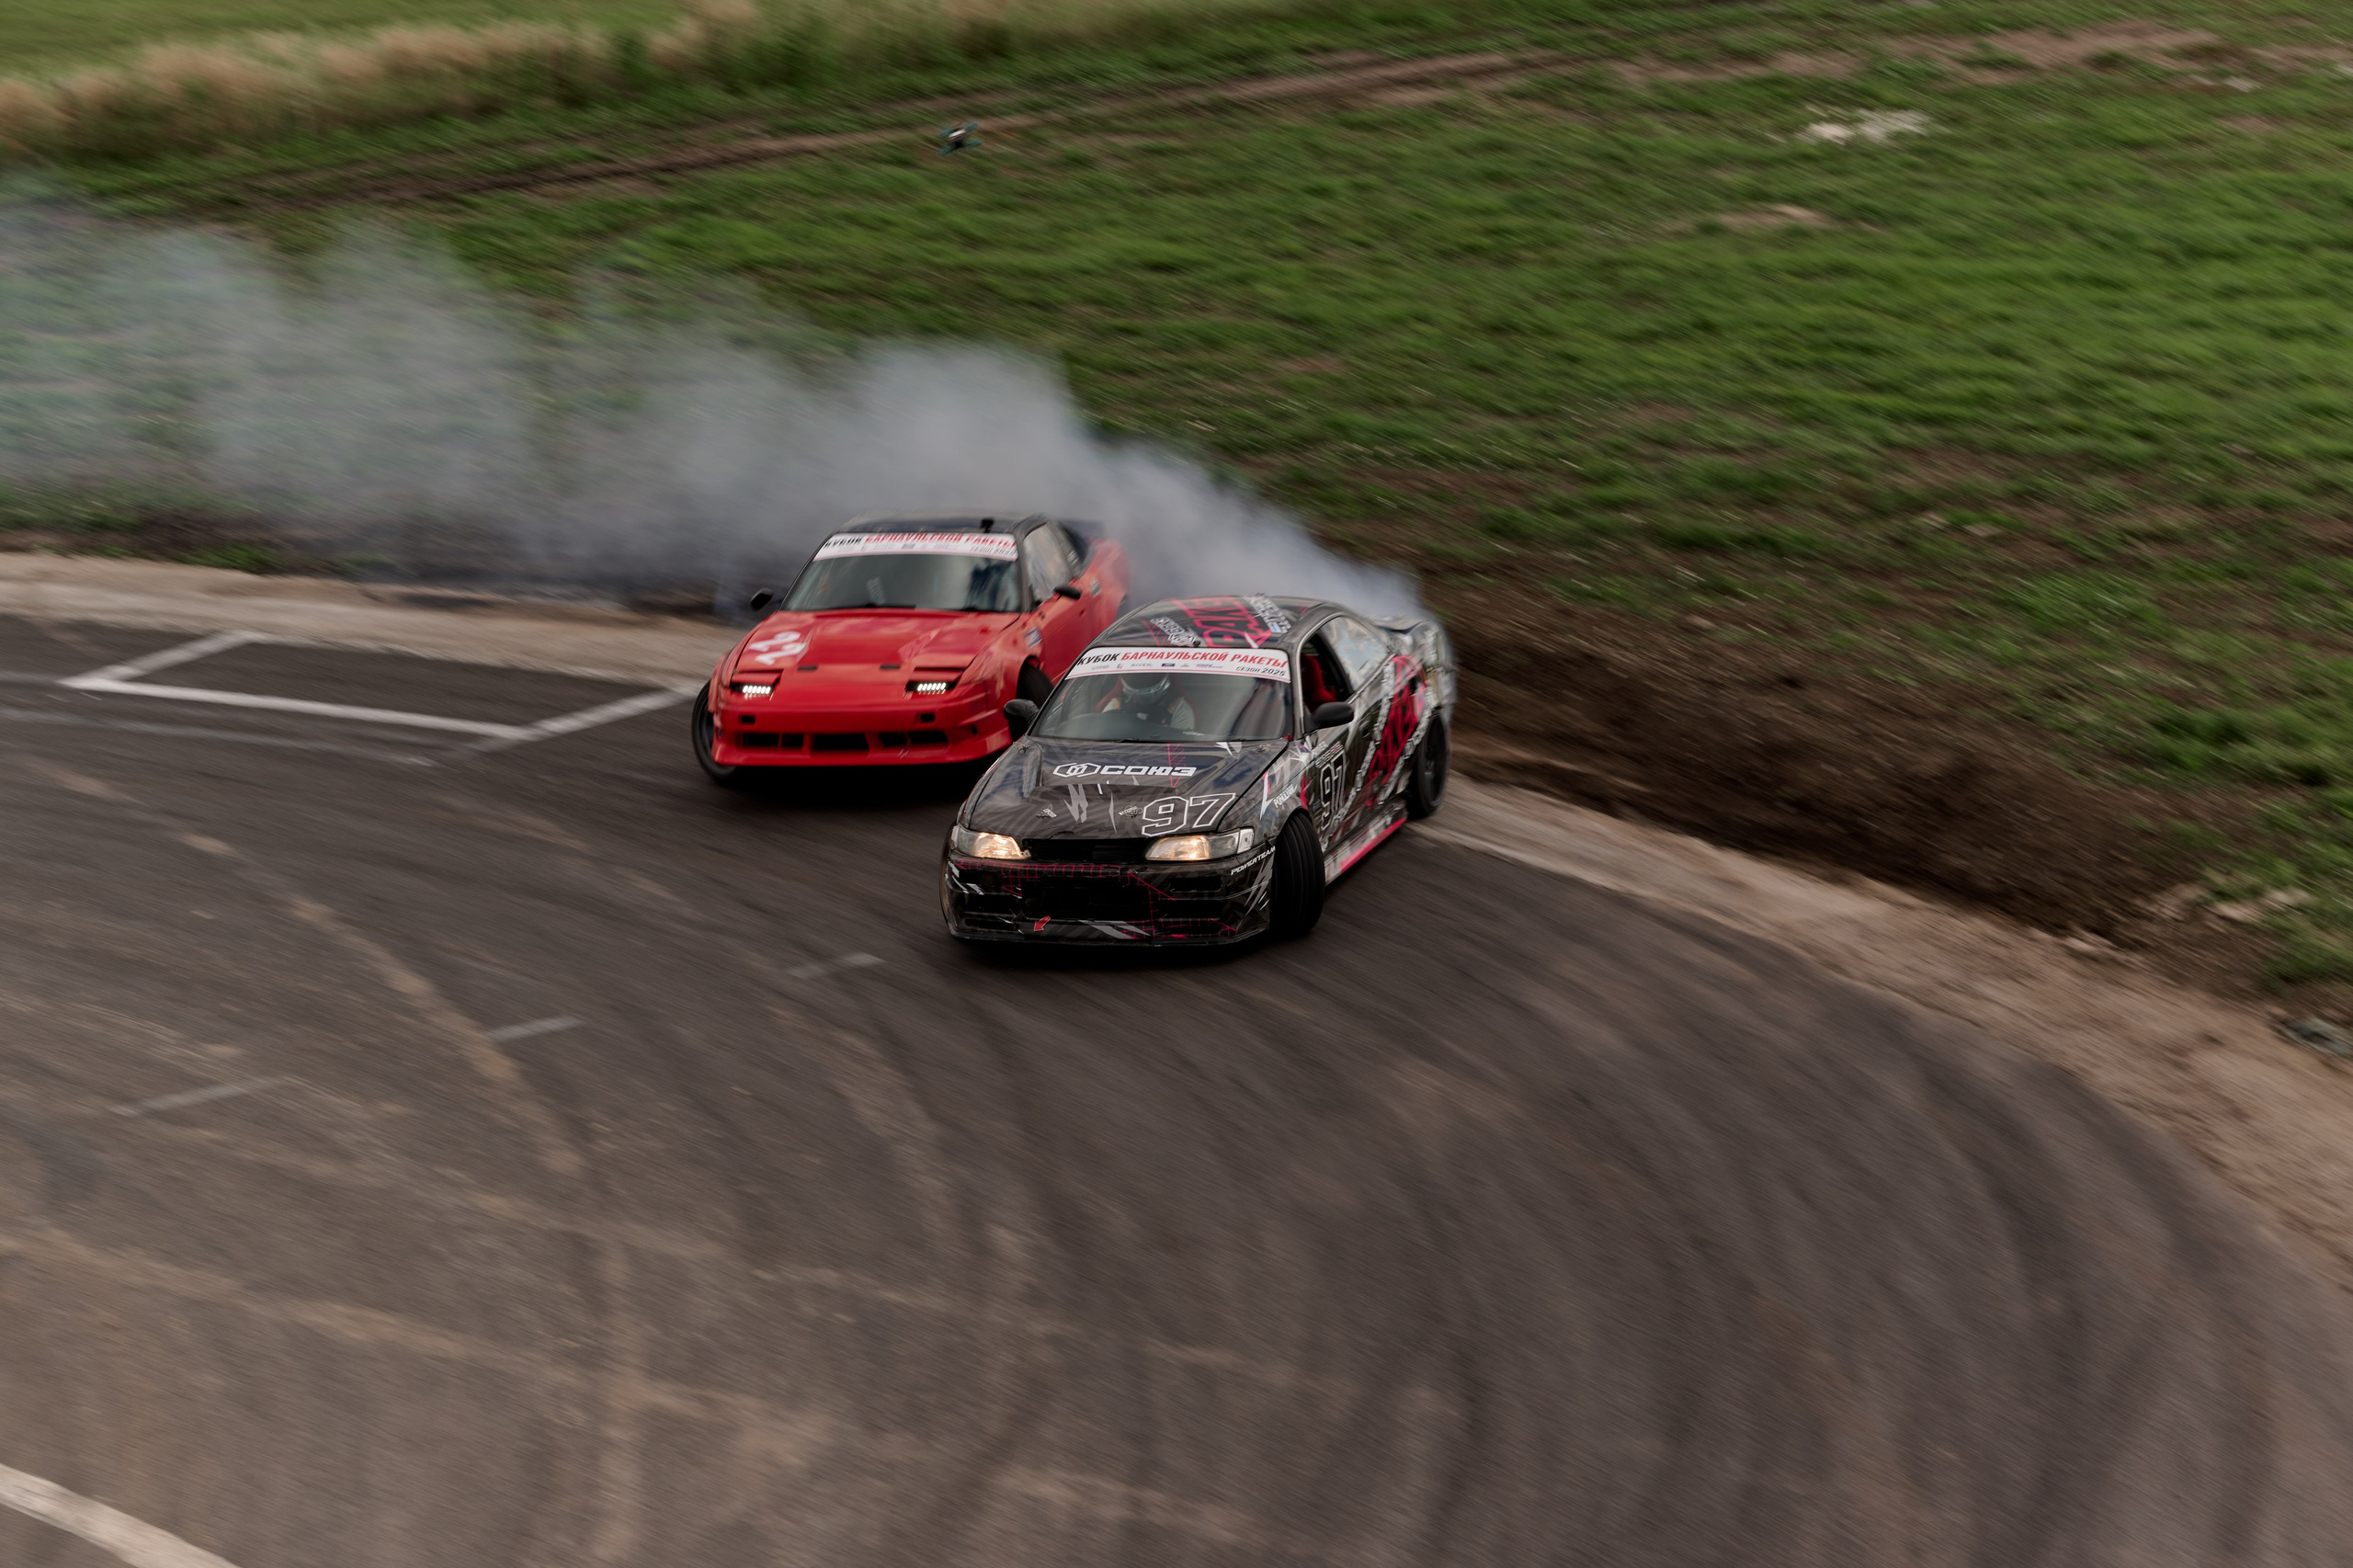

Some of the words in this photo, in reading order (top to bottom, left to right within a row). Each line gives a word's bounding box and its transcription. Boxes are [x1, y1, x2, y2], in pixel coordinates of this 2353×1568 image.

[1078, 653, 1120, 665] КУБОК
[1121, 652, 1228, 661] БАРНАУЛЬСКОЙ
[1231, 654, 1288, 667] РАКЕТЫ
[1261, 667, 1286, 676] 2025
[1100, 766, 1197, 777] СОЮЗ
[1142, 793, 1236, 837] 97
